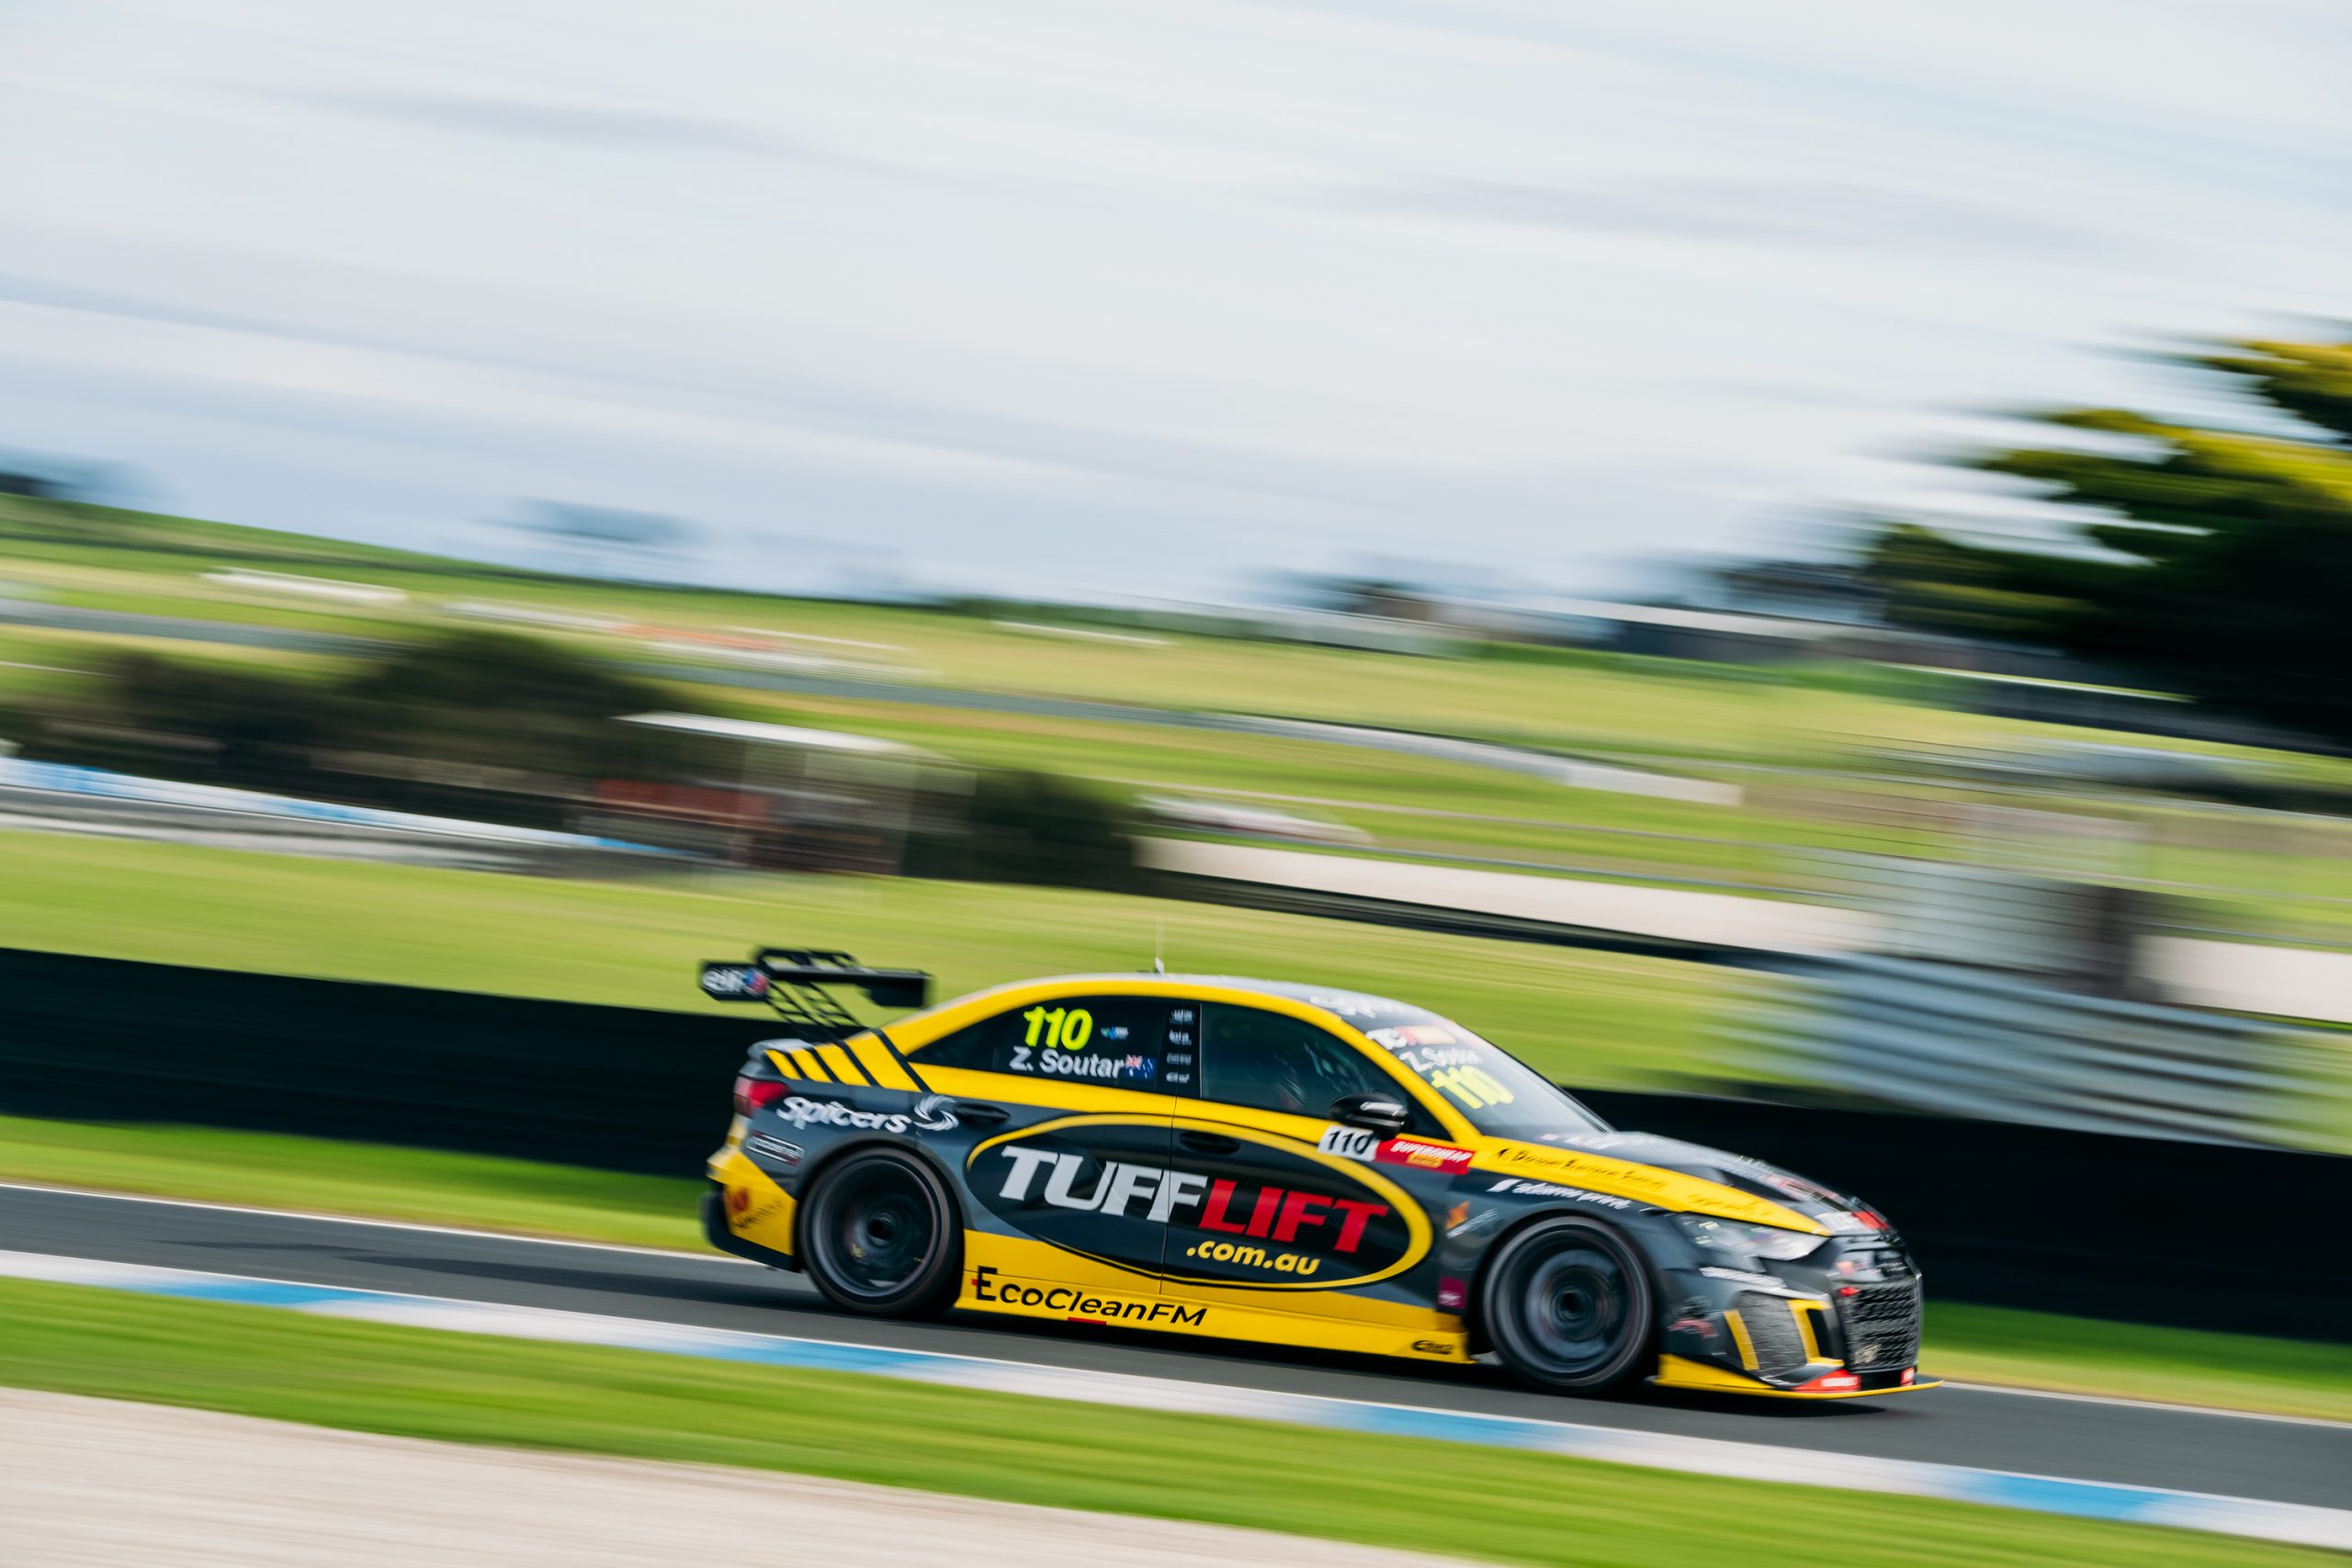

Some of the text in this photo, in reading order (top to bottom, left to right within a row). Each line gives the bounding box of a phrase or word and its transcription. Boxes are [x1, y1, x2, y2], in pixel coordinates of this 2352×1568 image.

[1023, 1006, 1093, 1051] 110
[1009, 1045, 1125, 1079] Z. Soutar
[1329, 1131, 1374, 1156] 110
[1186, 1240, 1321, 1276] .com.au
[976, 1265, 1208, 1326] EcoCleanFM
